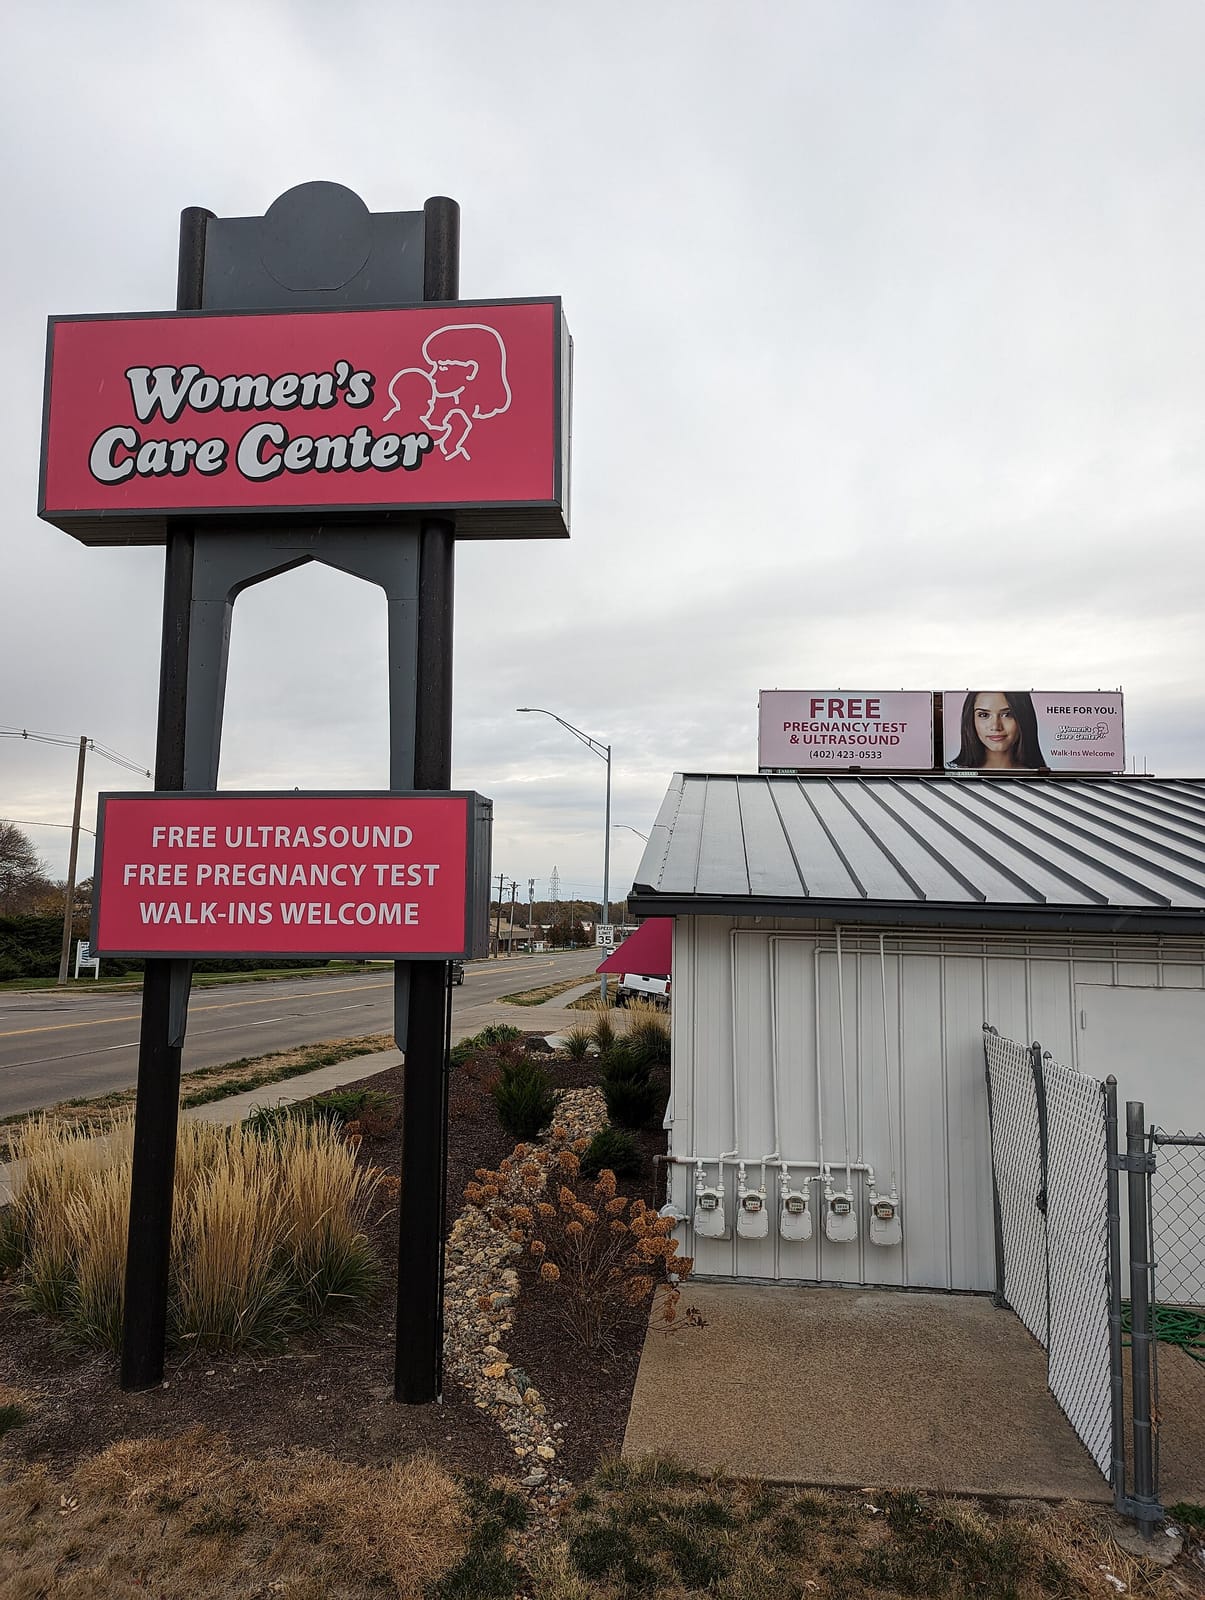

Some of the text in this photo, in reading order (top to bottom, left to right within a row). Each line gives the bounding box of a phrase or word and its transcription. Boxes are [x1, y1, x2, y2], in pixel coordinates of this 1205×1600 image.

[125, 360, 376, 424] Women's
[89, 421, 434, 486] Care Center
[810, 698, 881, 719] FREE
[1046, 706, 1117, 715] HERE FOR YOU.
[783, 721, 907, 733] PREGNANCY TEST
[789, 734, 900, 745] & ULTRASOUND
[809, 750, 882, 760] (402) 423-0533
[1050, 749, 1115, 757] Walk-Ins Welcome
[152, 826, 413, 848] FREE ULTRASOUND
[123, 864, 440, 886] FREE PREGNANCY TEST
[139, 902, 419, 925] WALK-INS WELCOME
[597, 935, 612, 945] 35
